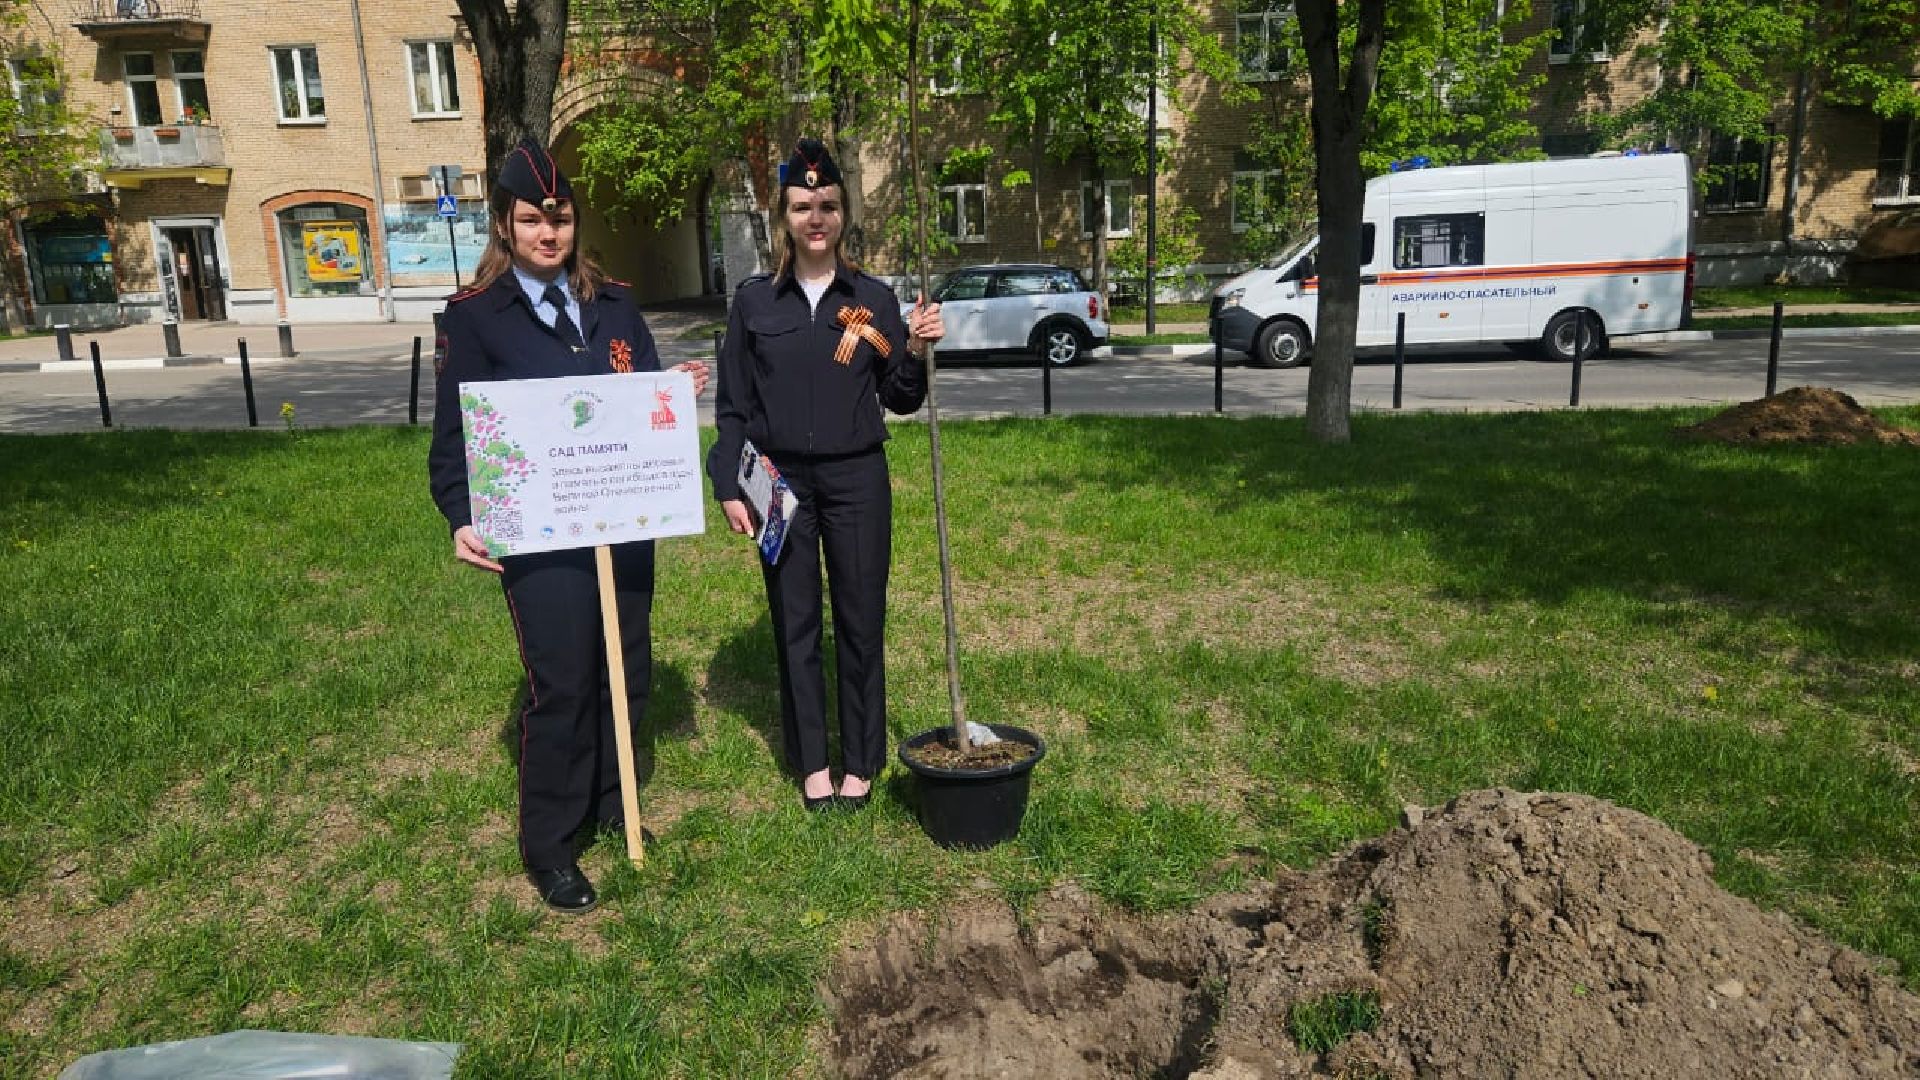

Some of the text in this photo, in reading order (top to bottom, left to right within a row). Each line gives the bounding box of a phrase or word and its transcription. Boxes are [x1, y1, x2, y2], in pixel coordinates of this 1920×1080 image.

[1392, 286, 1556, 302] АВАРИЙНО-СПАСАТЕЛЬНЫЙ
[549, 443, 628, 458] САД ПАМЯТИ
